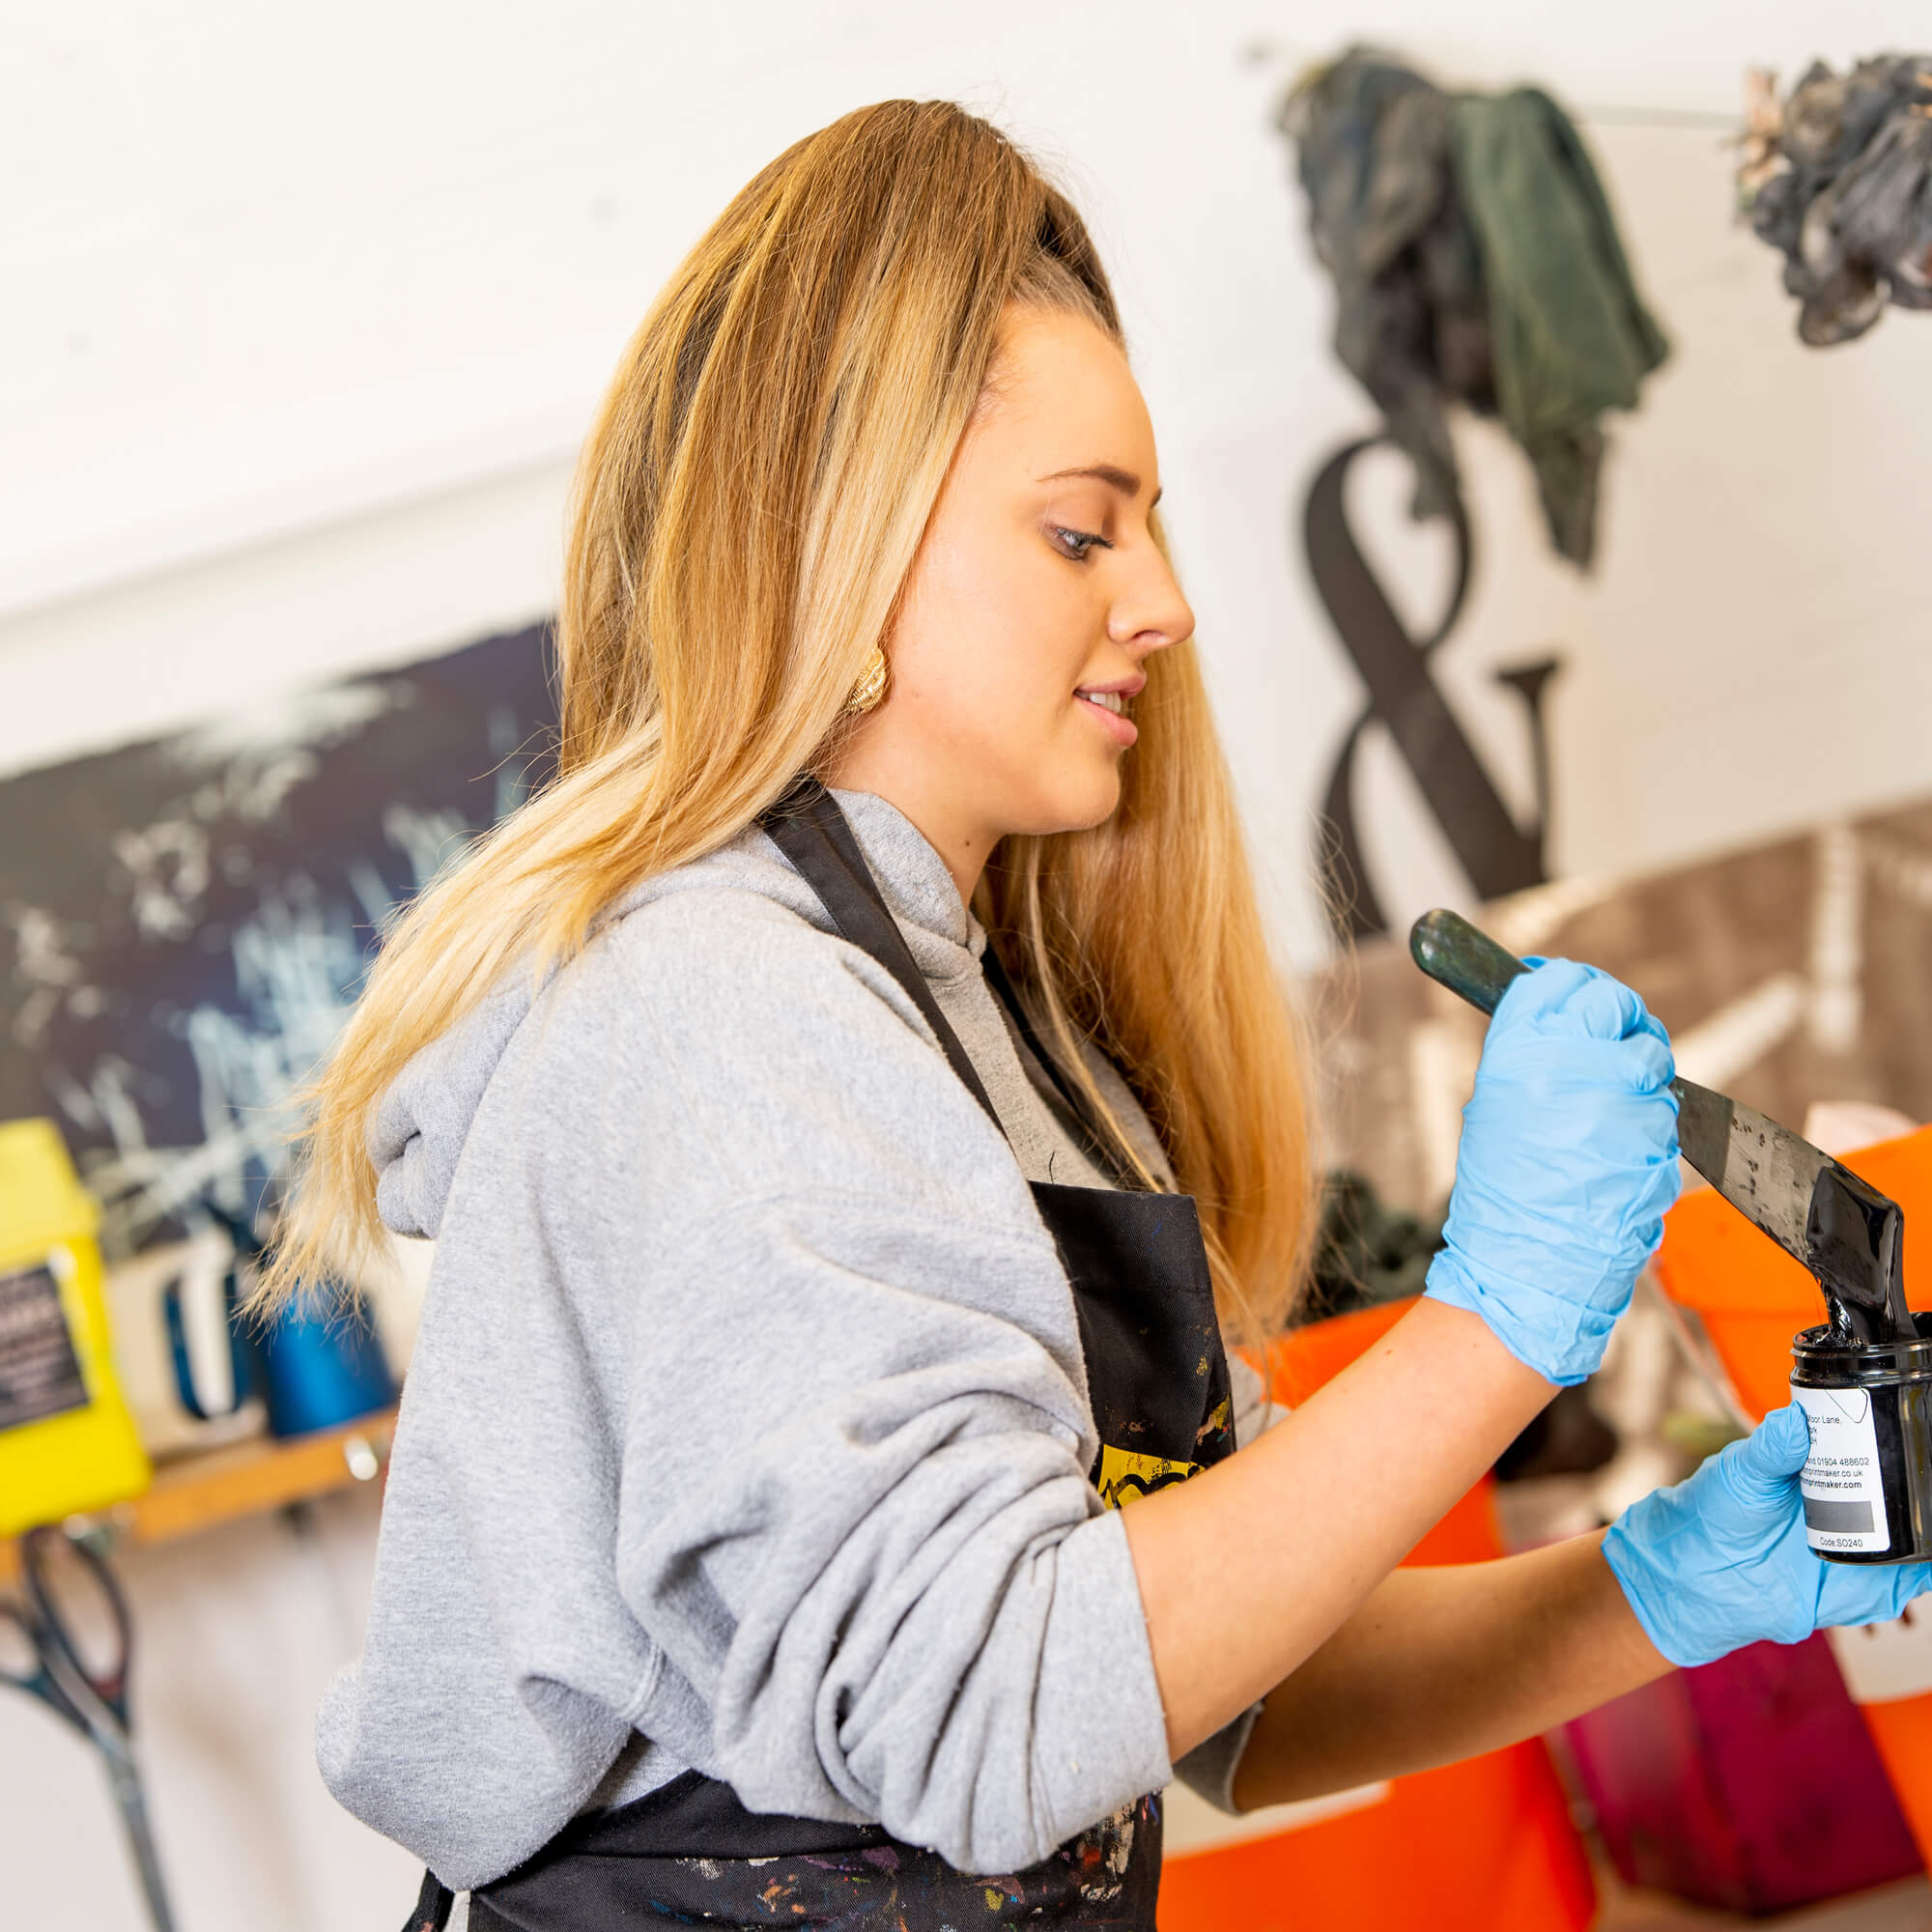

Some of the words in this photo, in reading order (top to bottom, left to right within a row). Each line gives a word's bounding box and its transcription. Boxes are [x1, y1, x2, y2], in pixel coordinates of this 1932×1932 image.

[1305, 433, 1562, 934] &
[1817, 1457, 1837, 1466] 01904
[1839, 1457, 1870, 1466] 488602
